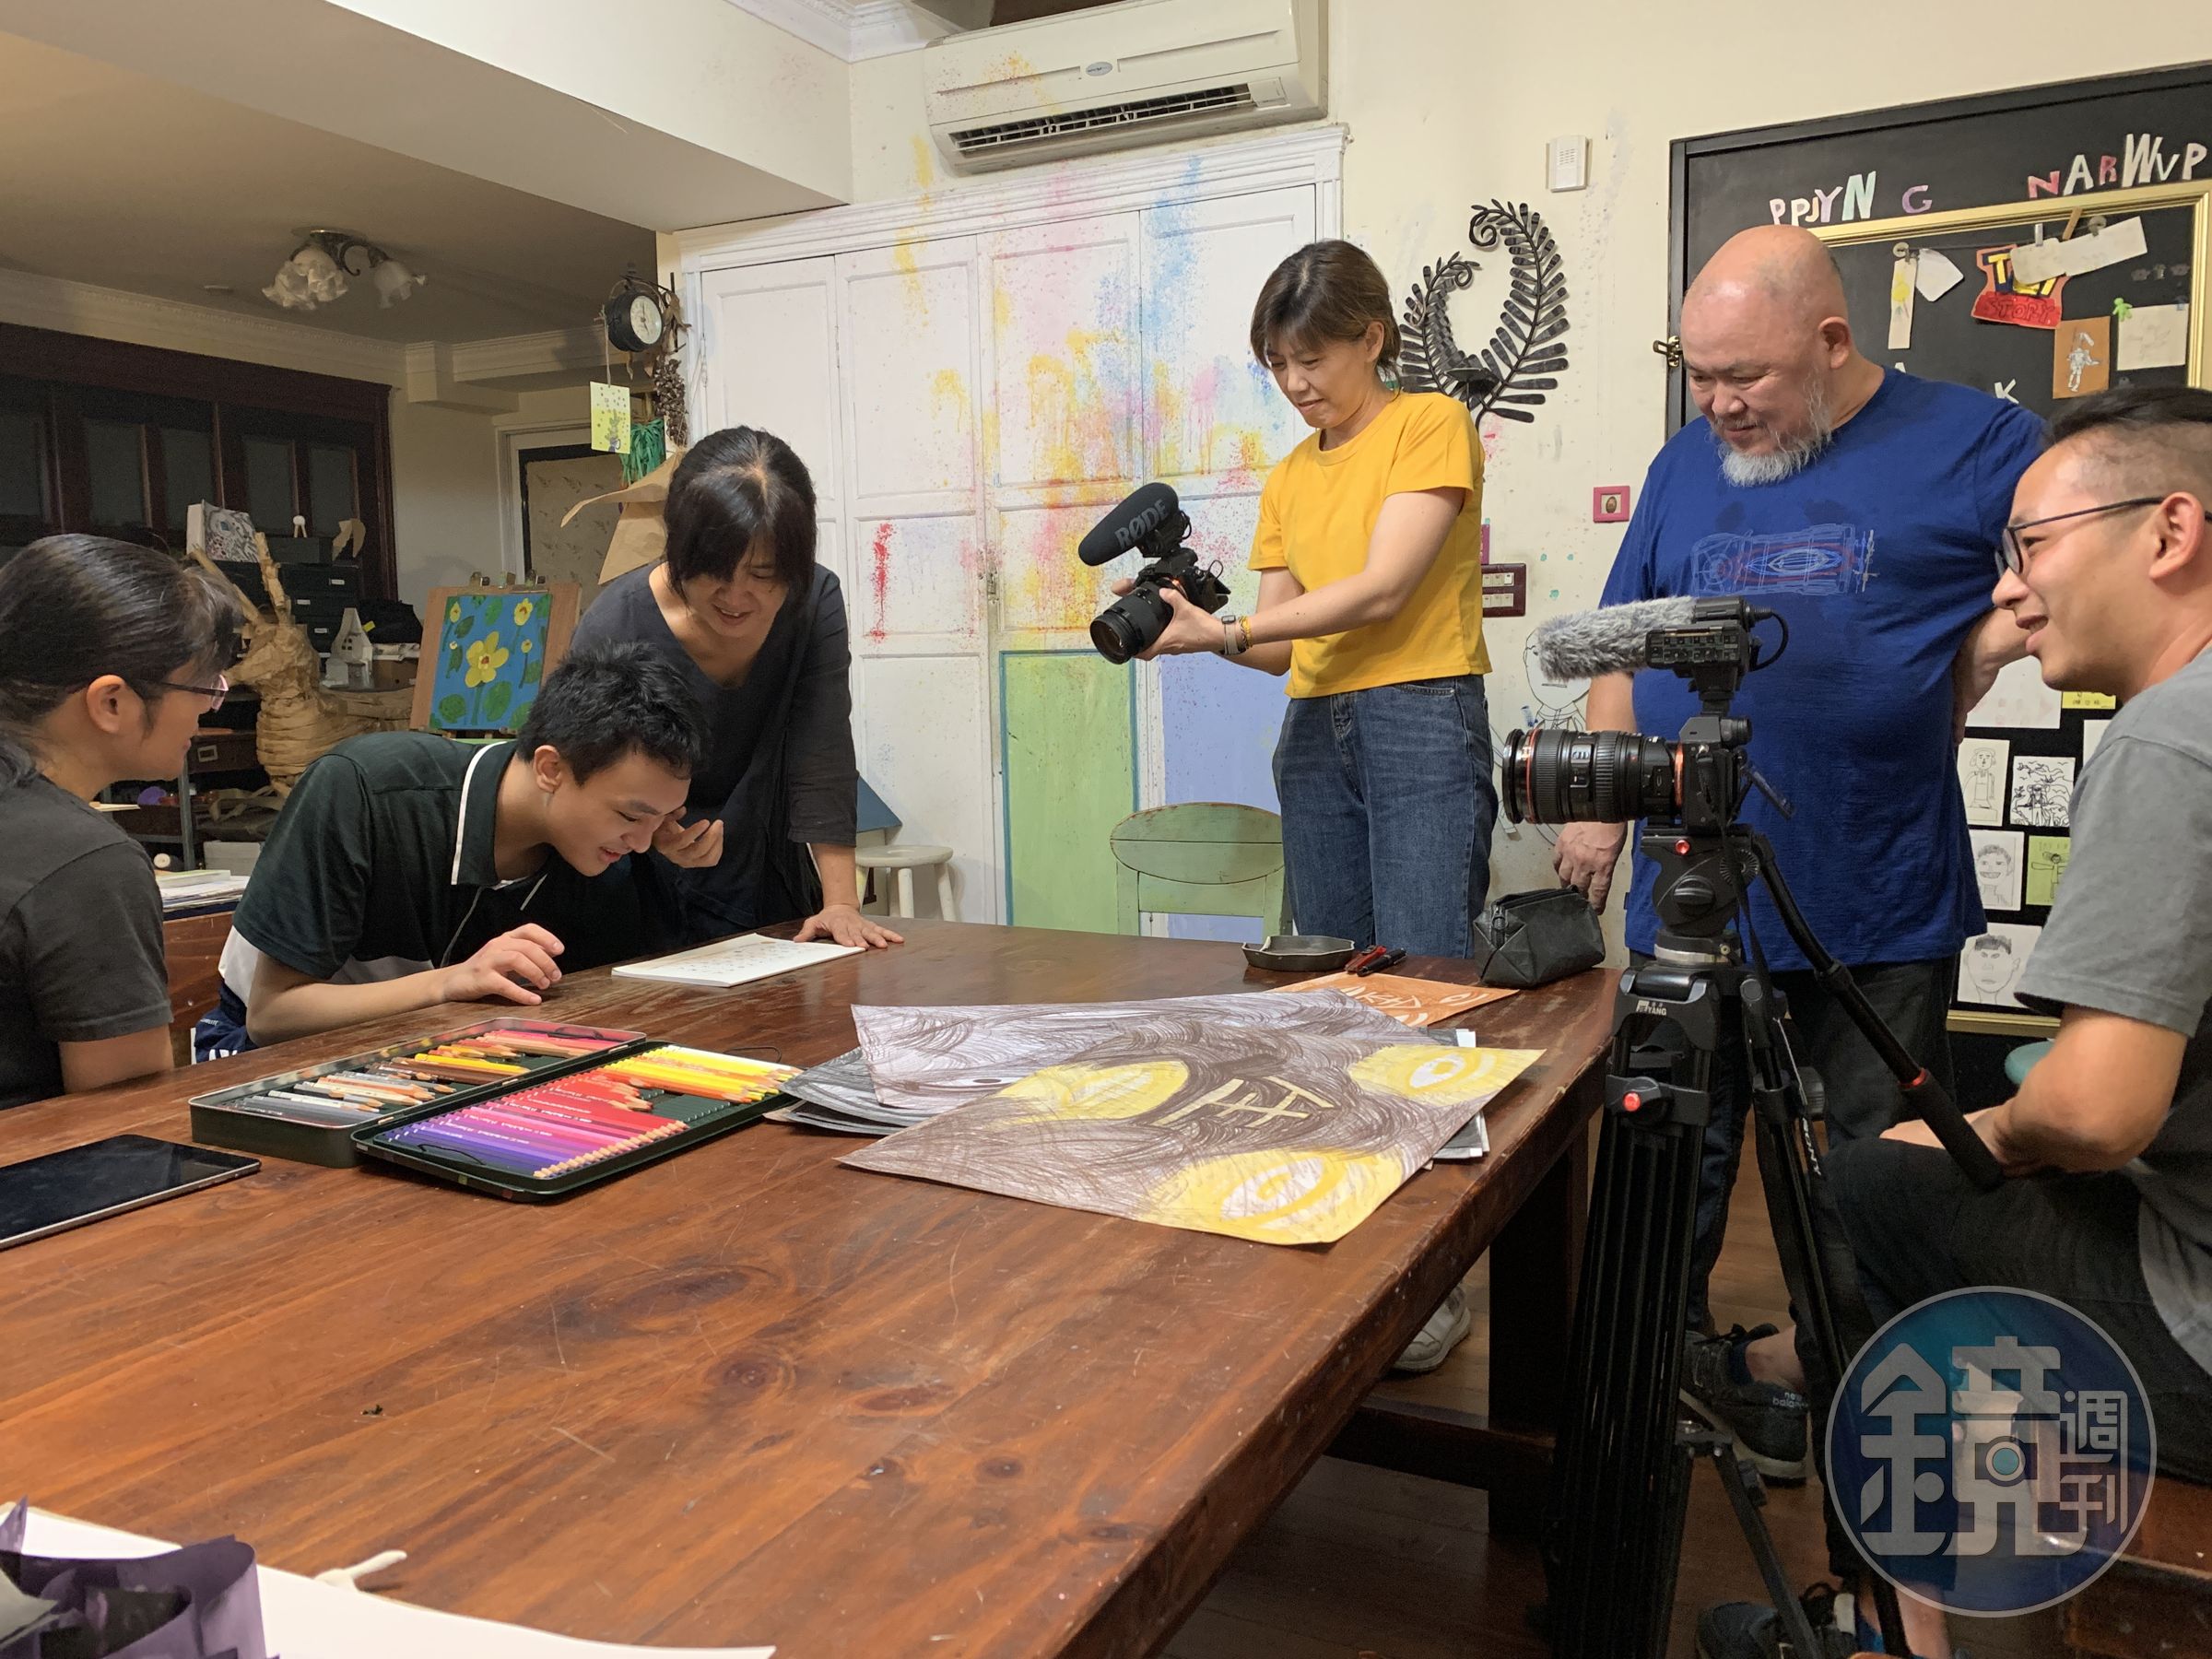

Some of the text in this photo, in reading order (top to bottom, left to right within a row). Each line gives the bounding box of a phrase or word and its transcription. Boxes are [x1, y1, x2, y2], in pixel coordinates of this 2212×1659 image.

[1901, 185, 1933, 213] G
[1990, 297, 2056, 324] STORY
[1994, 378, 2019, 404] K
